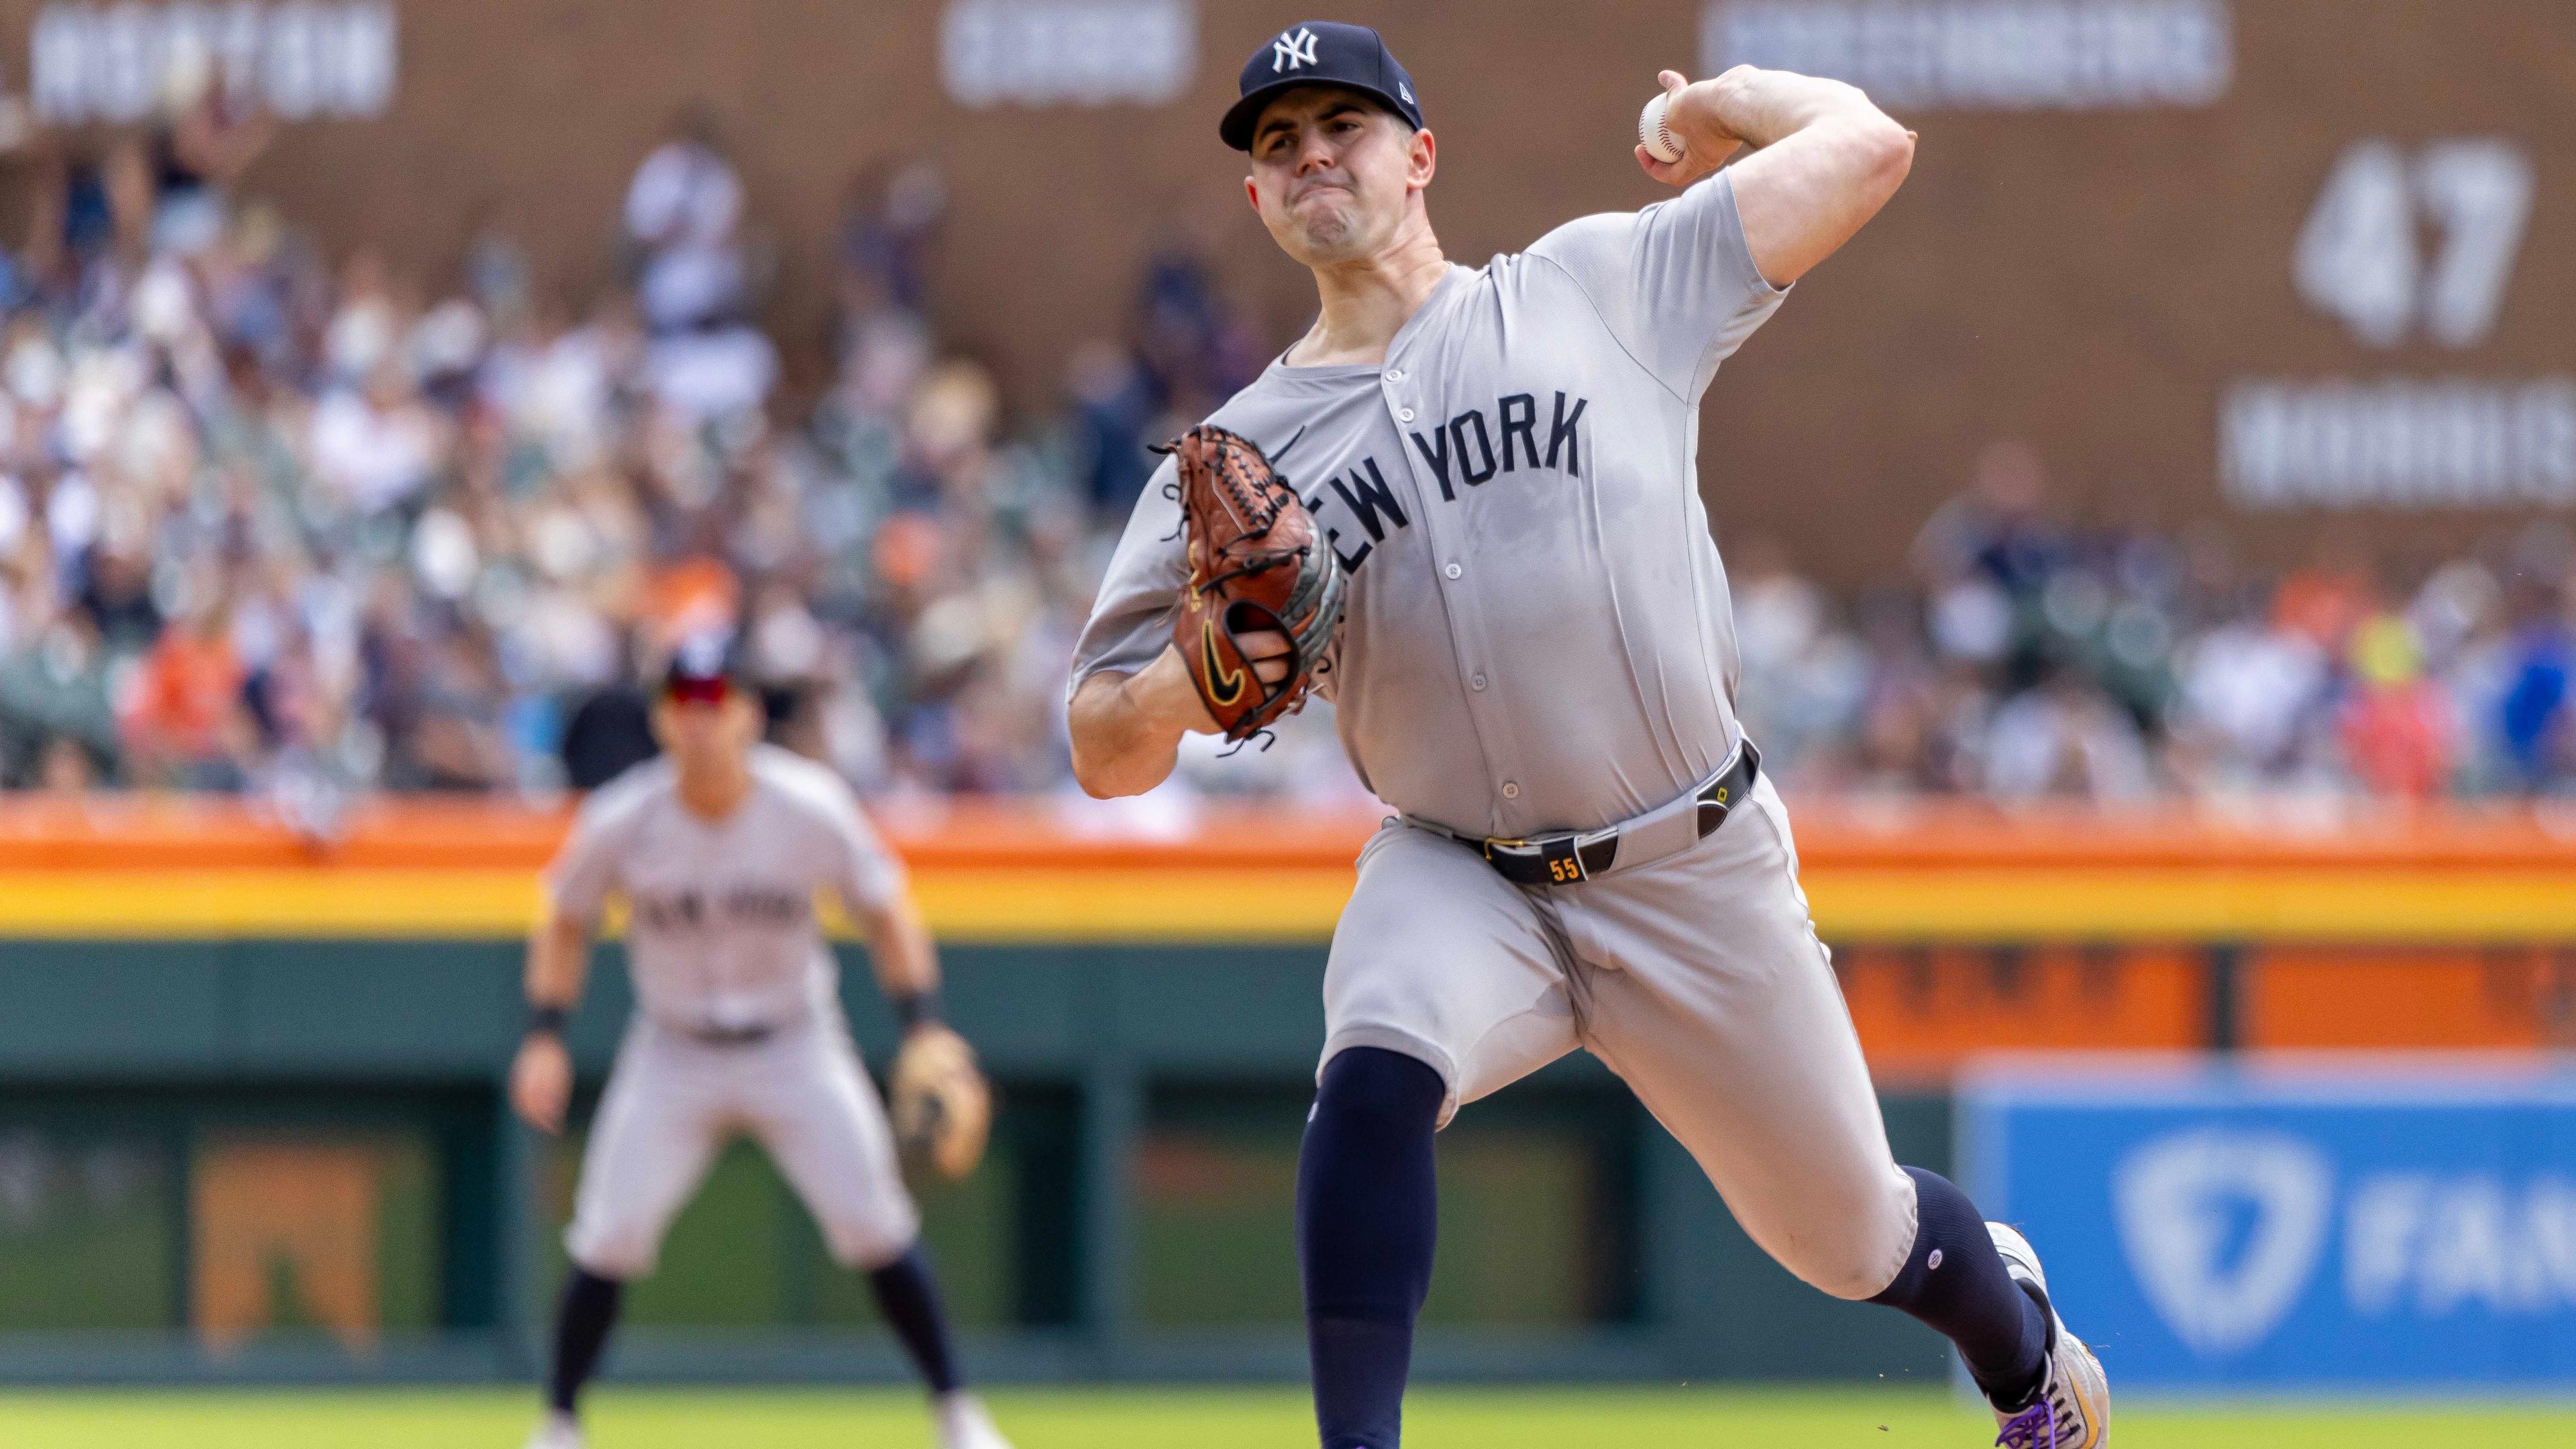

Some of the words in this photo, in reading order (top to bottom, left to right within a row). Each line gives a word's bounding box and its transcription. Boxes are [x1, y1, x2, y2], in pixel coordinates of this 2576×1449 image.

[1272, 28, 1319, 73] NY
[2294, 140, 2534, 347] 47
[1307, 456, 1409, 576] EW
[1409, 390, 1588, 502] YORK
[1549, 856, 1579, 882] 55
